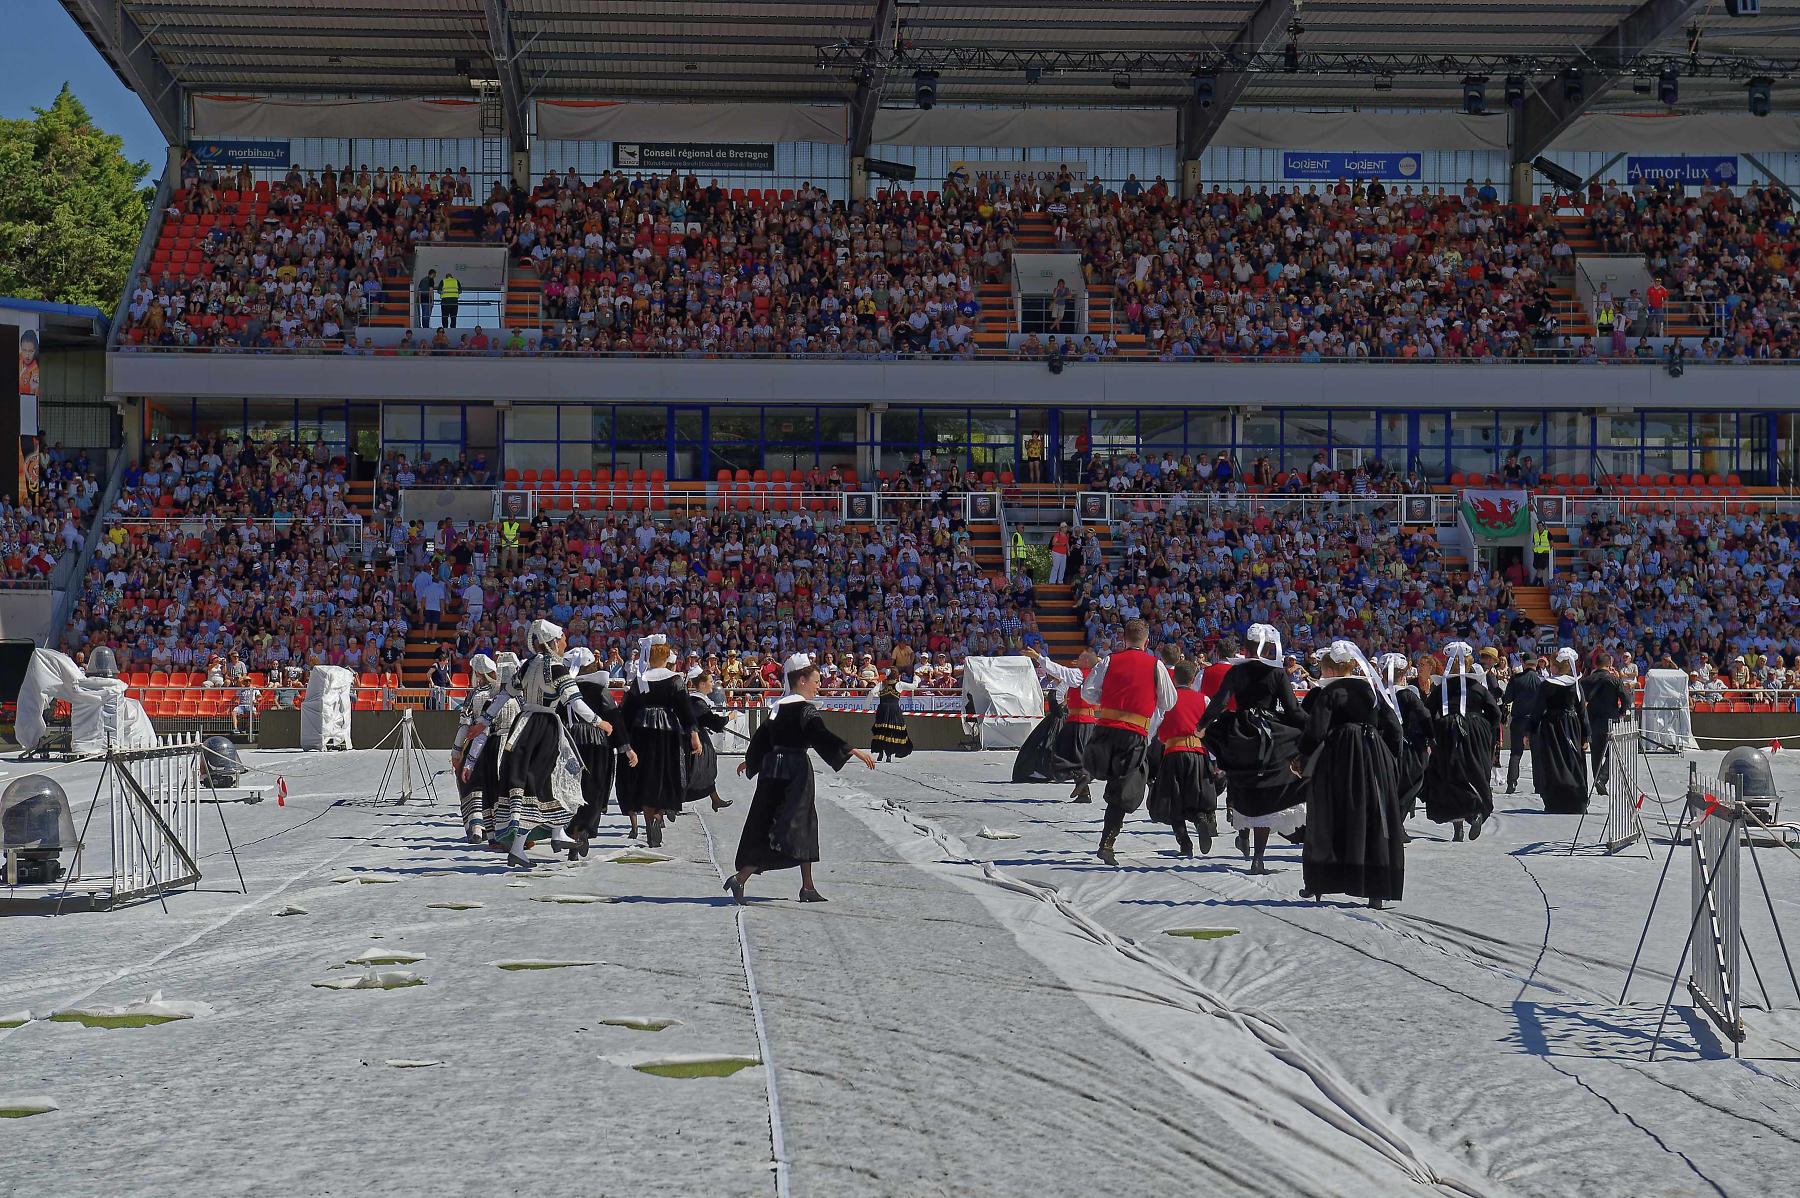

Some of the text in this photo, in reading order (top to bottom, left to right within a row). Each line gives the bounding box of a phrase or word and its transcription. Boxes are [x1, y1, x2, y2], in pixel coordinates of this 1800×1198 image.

[228, 148, 285, 158] morbihan.fr
[643, 147, 769, 161] Conseil régional de Bretagne
